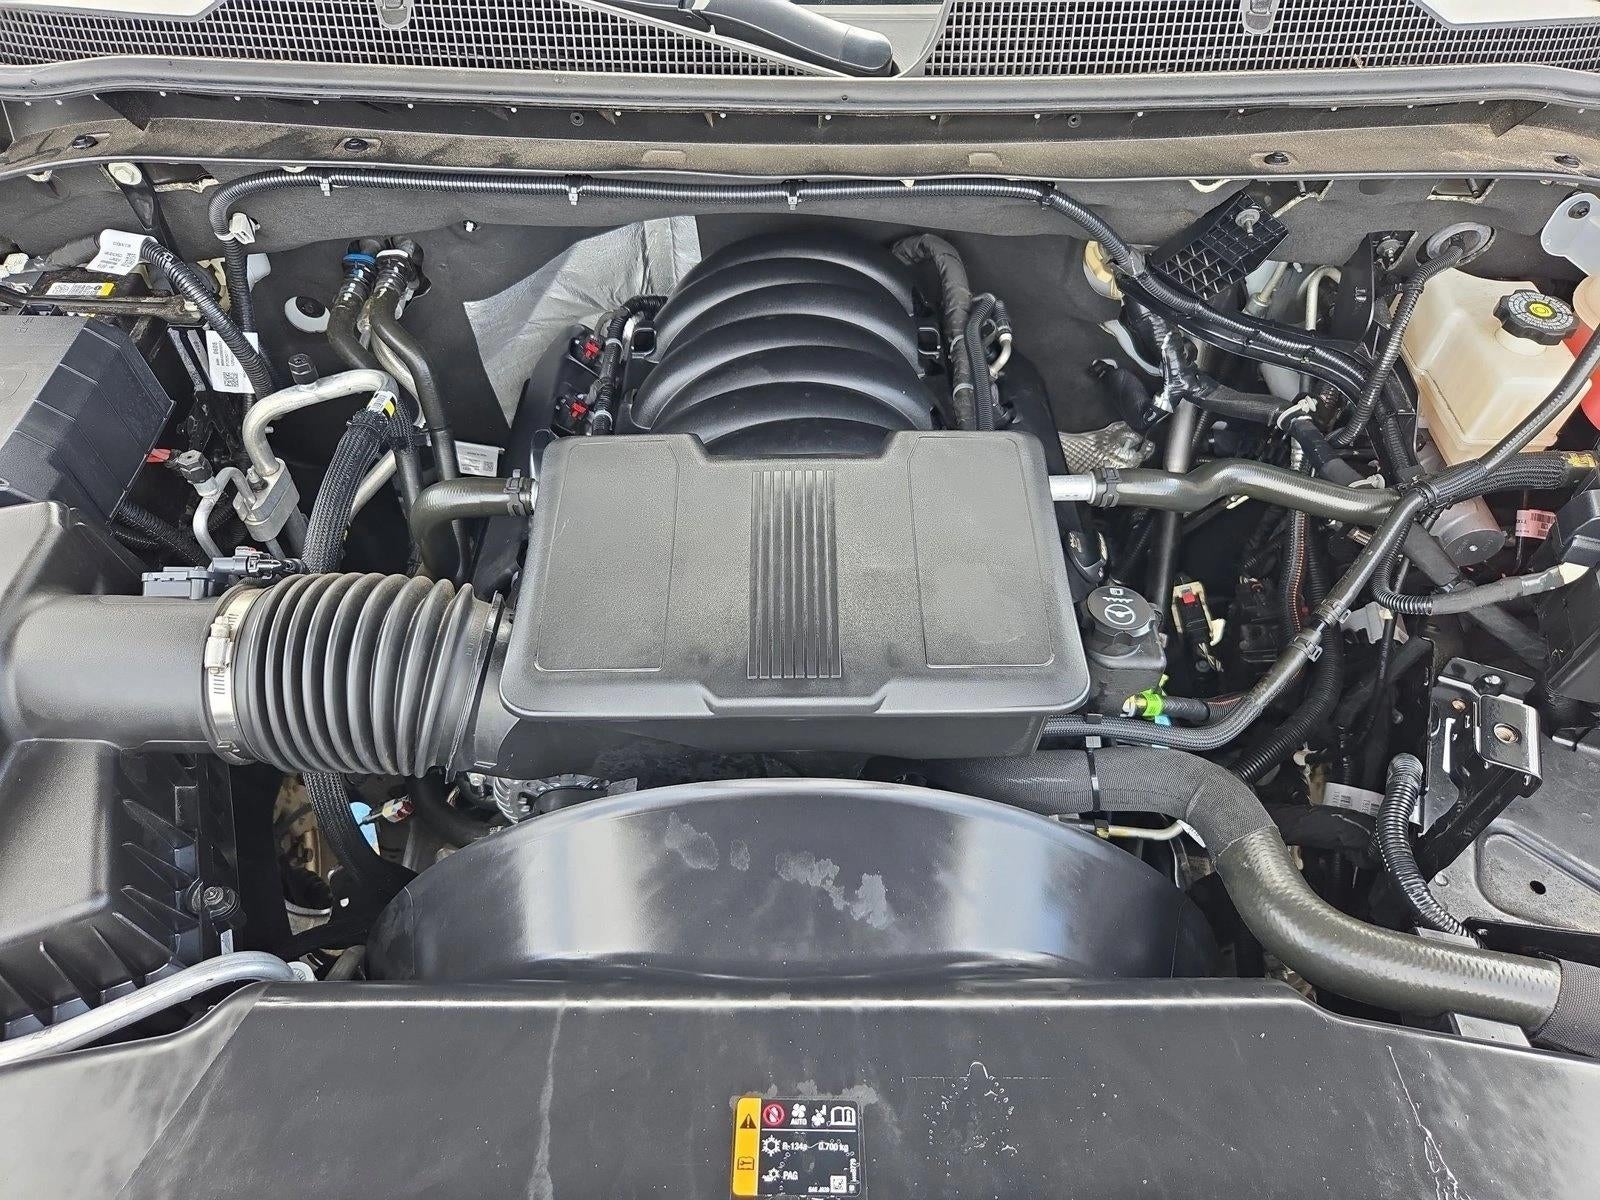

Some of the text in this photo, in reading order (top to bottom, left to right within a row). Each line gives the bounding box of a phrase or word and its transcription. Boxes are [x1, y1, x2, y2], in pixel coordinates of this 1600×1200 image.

[818, 1141, 839, 1151] 0.700
[839, 1142, 849, 1153] kg
[783, 1171, 798, 1180] PAG
